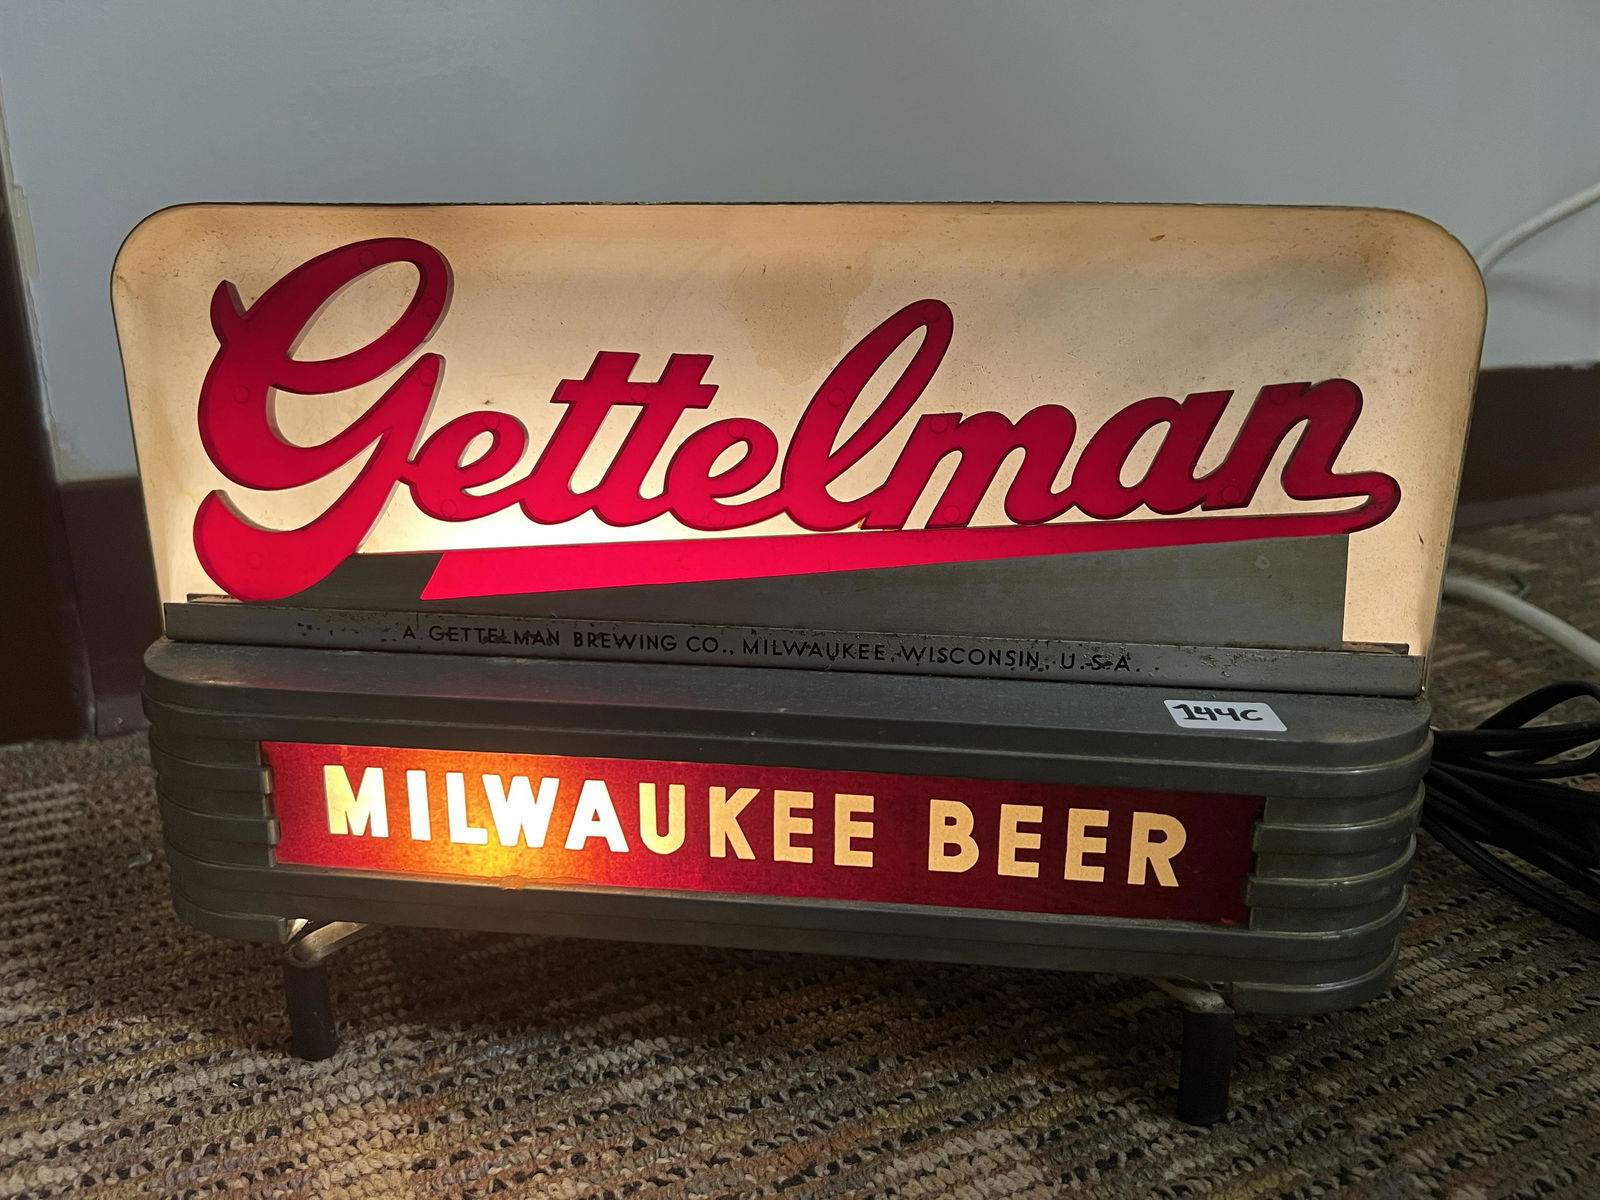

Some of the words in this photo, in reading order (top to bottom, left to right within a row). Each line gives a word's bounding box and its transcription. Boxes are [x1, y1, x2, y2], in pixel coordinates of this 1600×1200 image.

[193, 236, 1401, 601] Gettelman
[429, 625, 560, 646] GETTELMAN
[574, 631, 678, 652] BREWING
[1172, 703, 1263, 722] 144C
[322, 764, 875, 868] MILWAUKEE
[928, 799, 1187, 888] BEER
